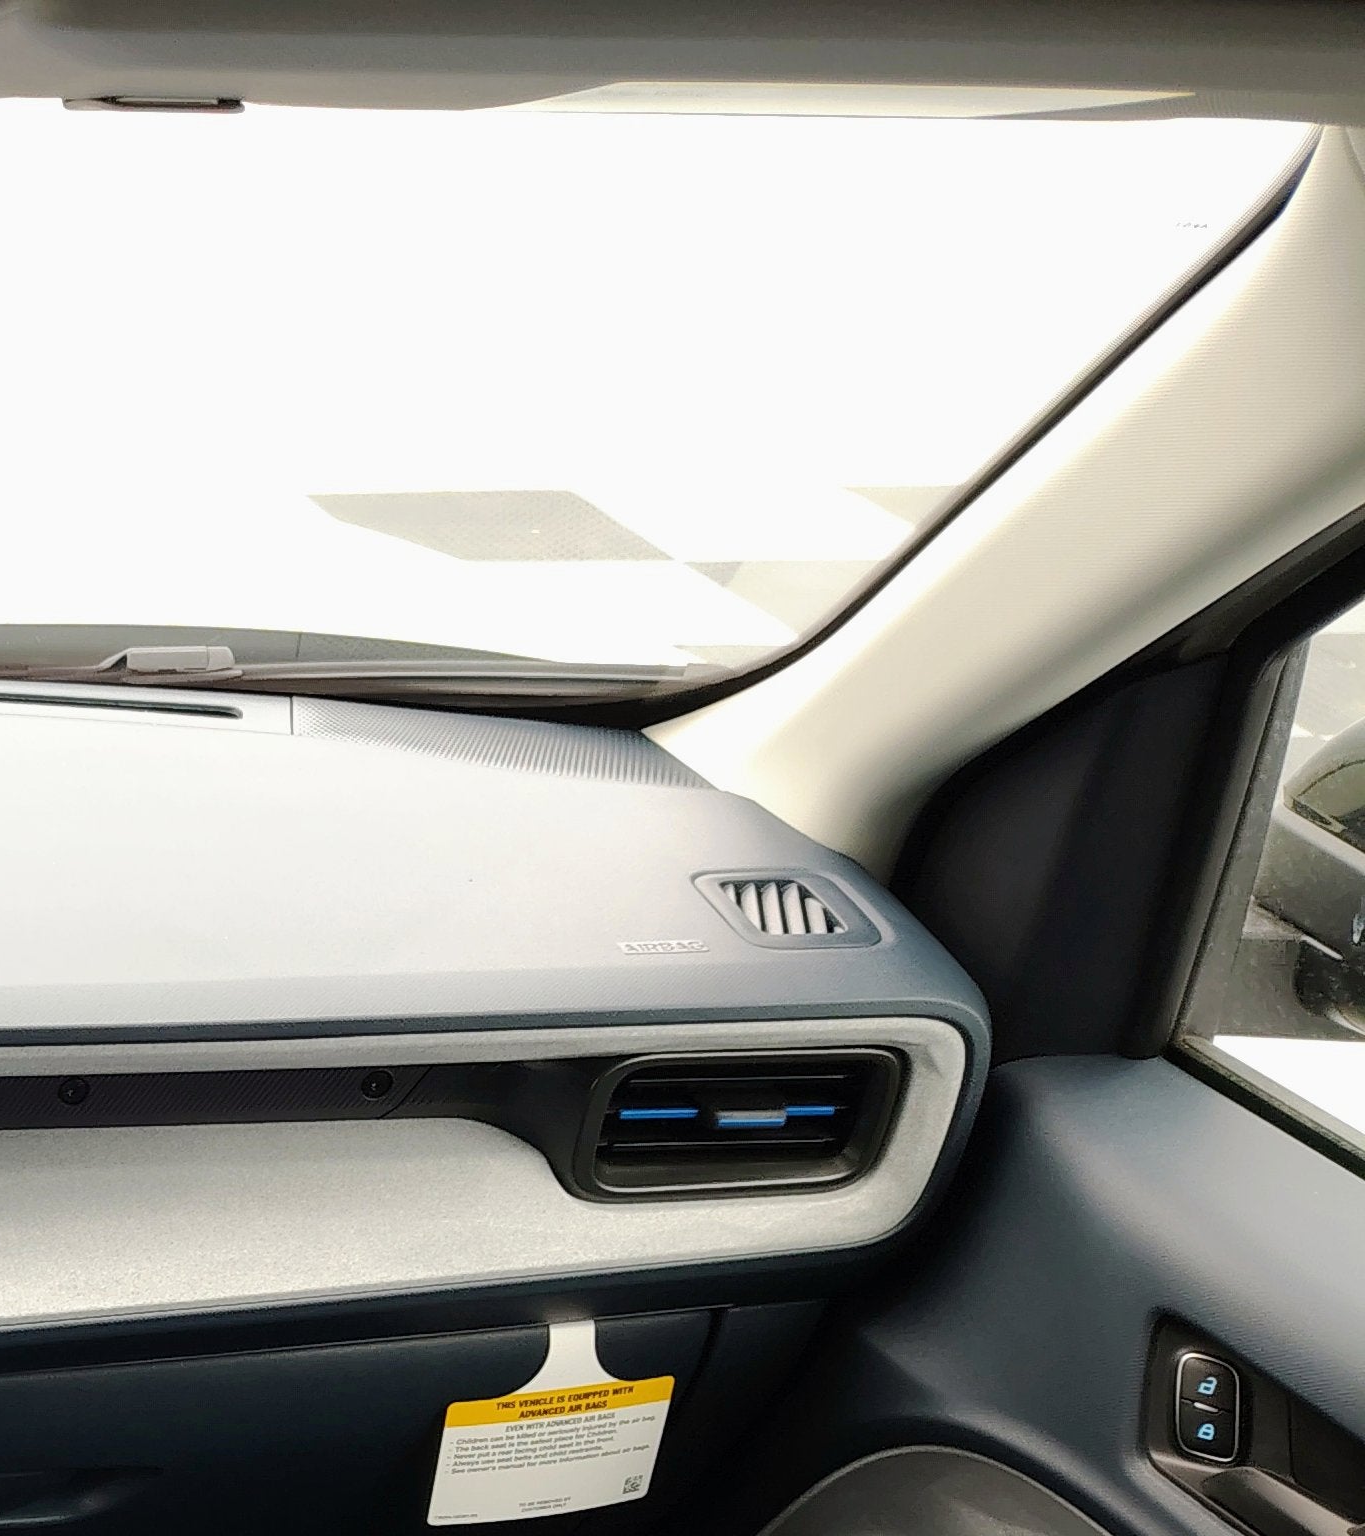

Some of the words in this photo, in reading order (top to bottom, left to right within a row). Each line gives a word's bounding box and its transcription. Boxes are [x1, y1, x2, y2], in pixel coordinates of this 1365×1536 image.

[496, 1400, 516, 1410] THIS
[518, 1396, 554, 1408] VEHICLE
[556, 1394, 565, 1403] IS
[567, 1389, 610, 1403] EQUIPPED
[612, 1386, 634, 1397] WITH
[518, 1406, 566, 1419] ADVANCED
[567, 1404, 583, 1413] AIR
[585, 1400, 608, 1411] BAGS
